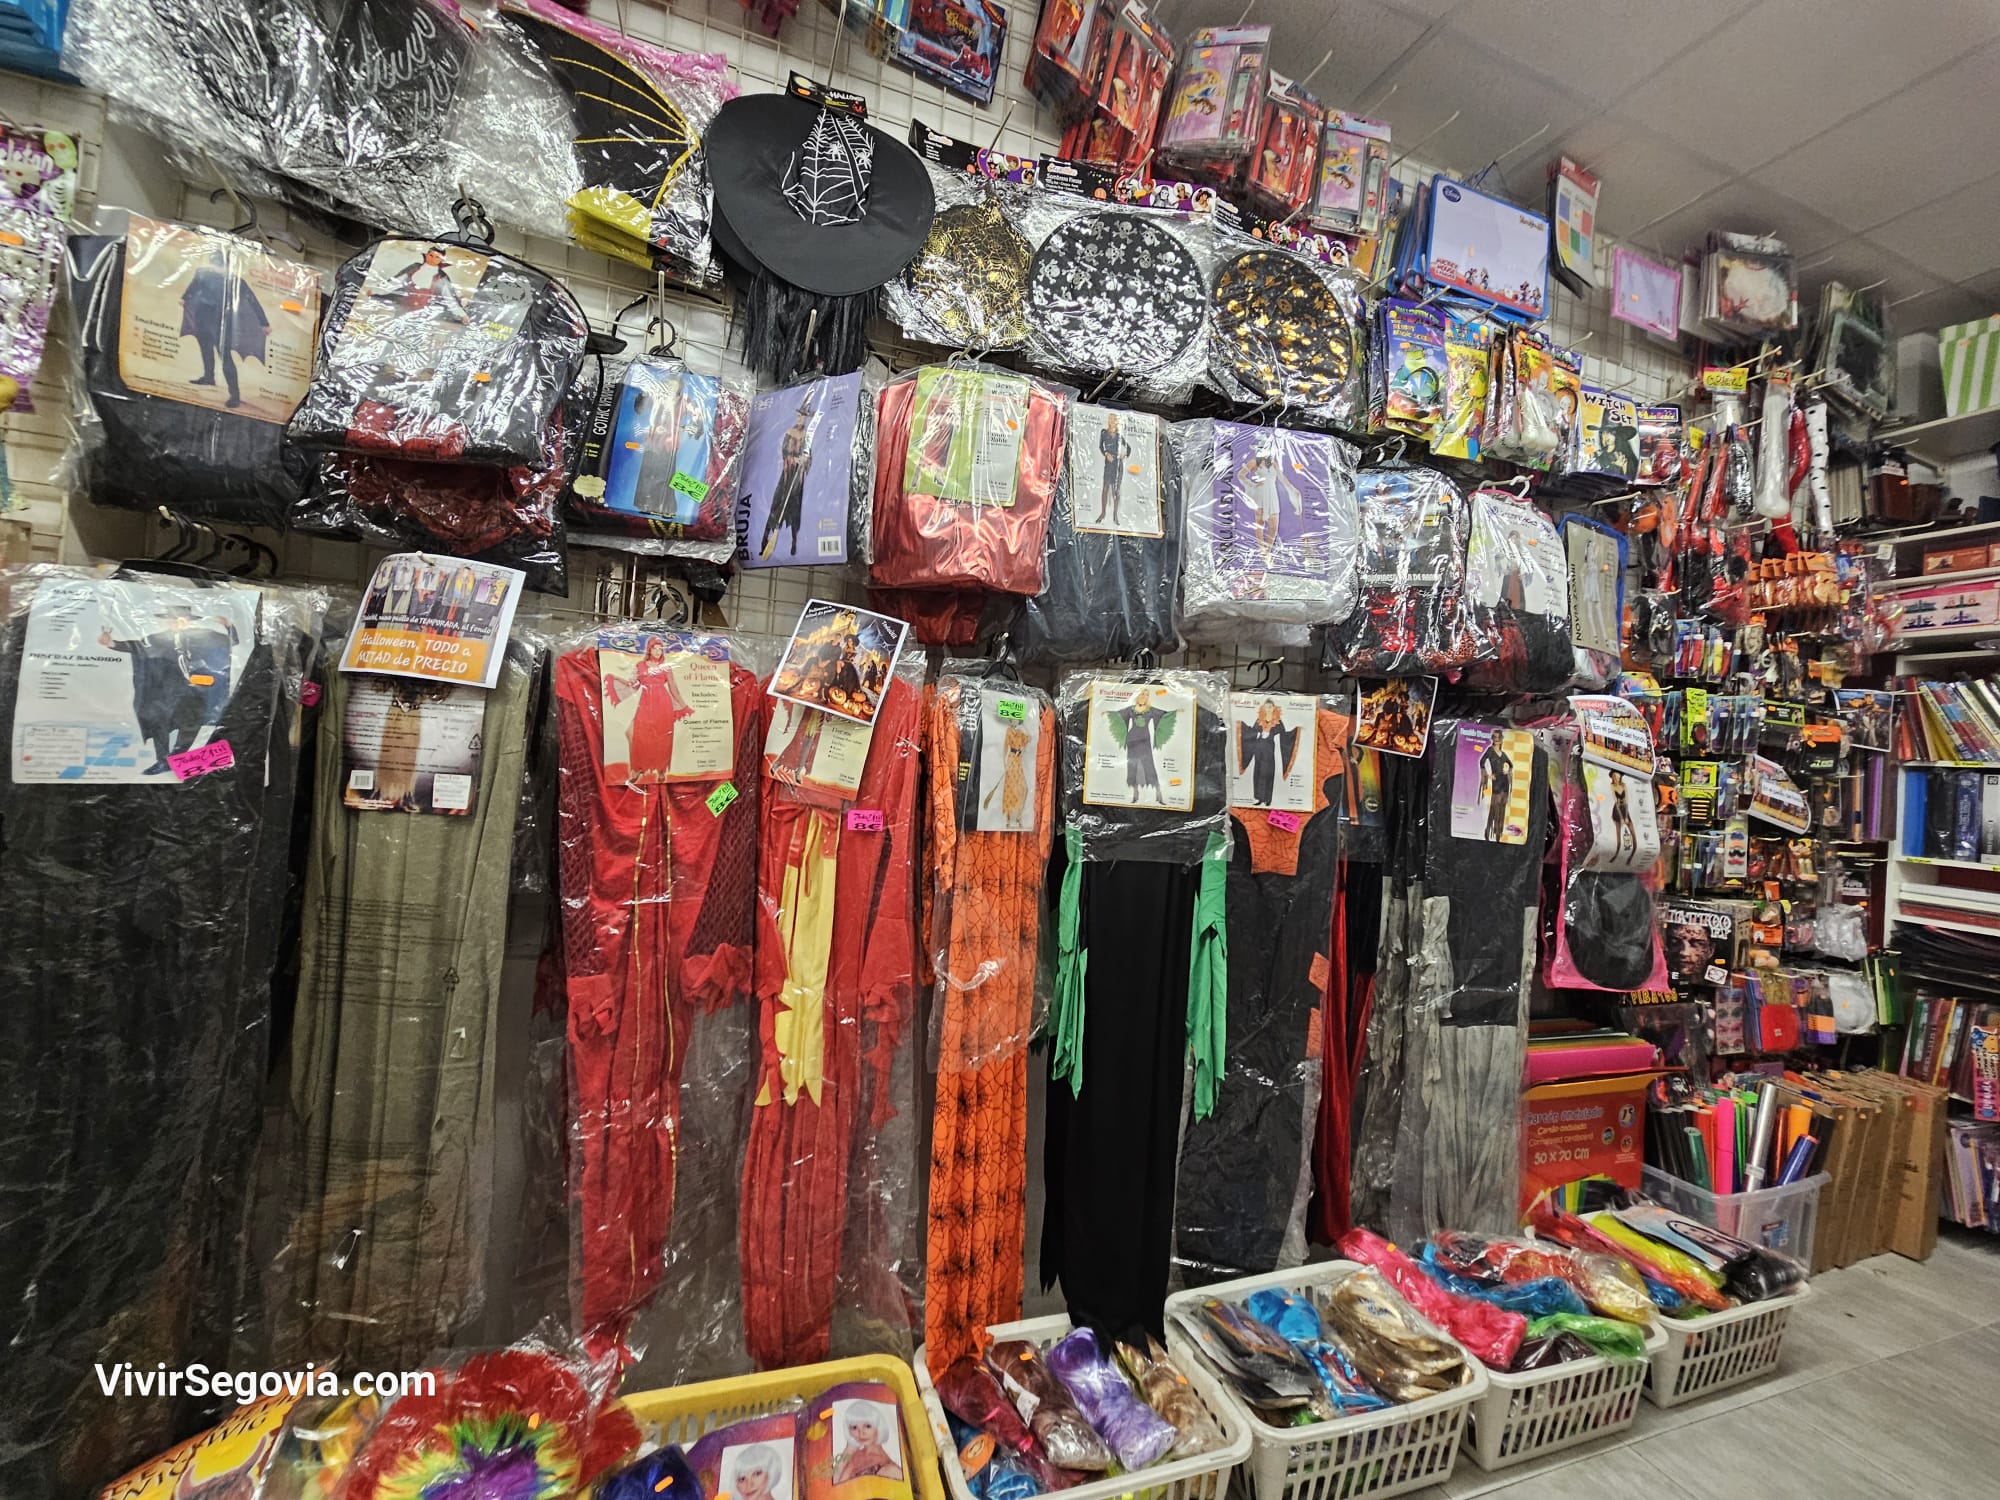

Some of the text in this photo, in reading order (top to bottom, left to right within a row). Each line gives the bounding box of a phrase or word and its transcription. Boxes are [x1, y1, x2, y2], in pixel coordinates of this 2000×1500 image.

[1584, 392, 1626, 411] WITCH
[592, 407, 611, 435] GOTHIC
[1610, 411, 1633, 425] SET
[1219, 442, 1234, 506] BLANA
[737, 493, 753, 561] BRUJA
[418, 617, 460, 631] TEMPORADA,
[470, 624, 492, 634] fondo
[1572, 604, 1582, 641] NOVIA
[361, 632, 472, 657] Halloween, TODO a
[77, 654, 122, 663] BANDIDO
[357, 650, 468, 674] MITAD de PRECIO
[690, 662, 718, 673] Queen
[695, 674, 720, 682] Flame
[999, 710, 1022, 719] 8€
[853, 822, 882, 831] 8€
[1667, 909, 1732, 930] TATTOO
[1534, 1152, 1547, 1165] 50
[1560, 1150, 1572, 1161] 70
[1574, 1148, 1590, 1160] CM
